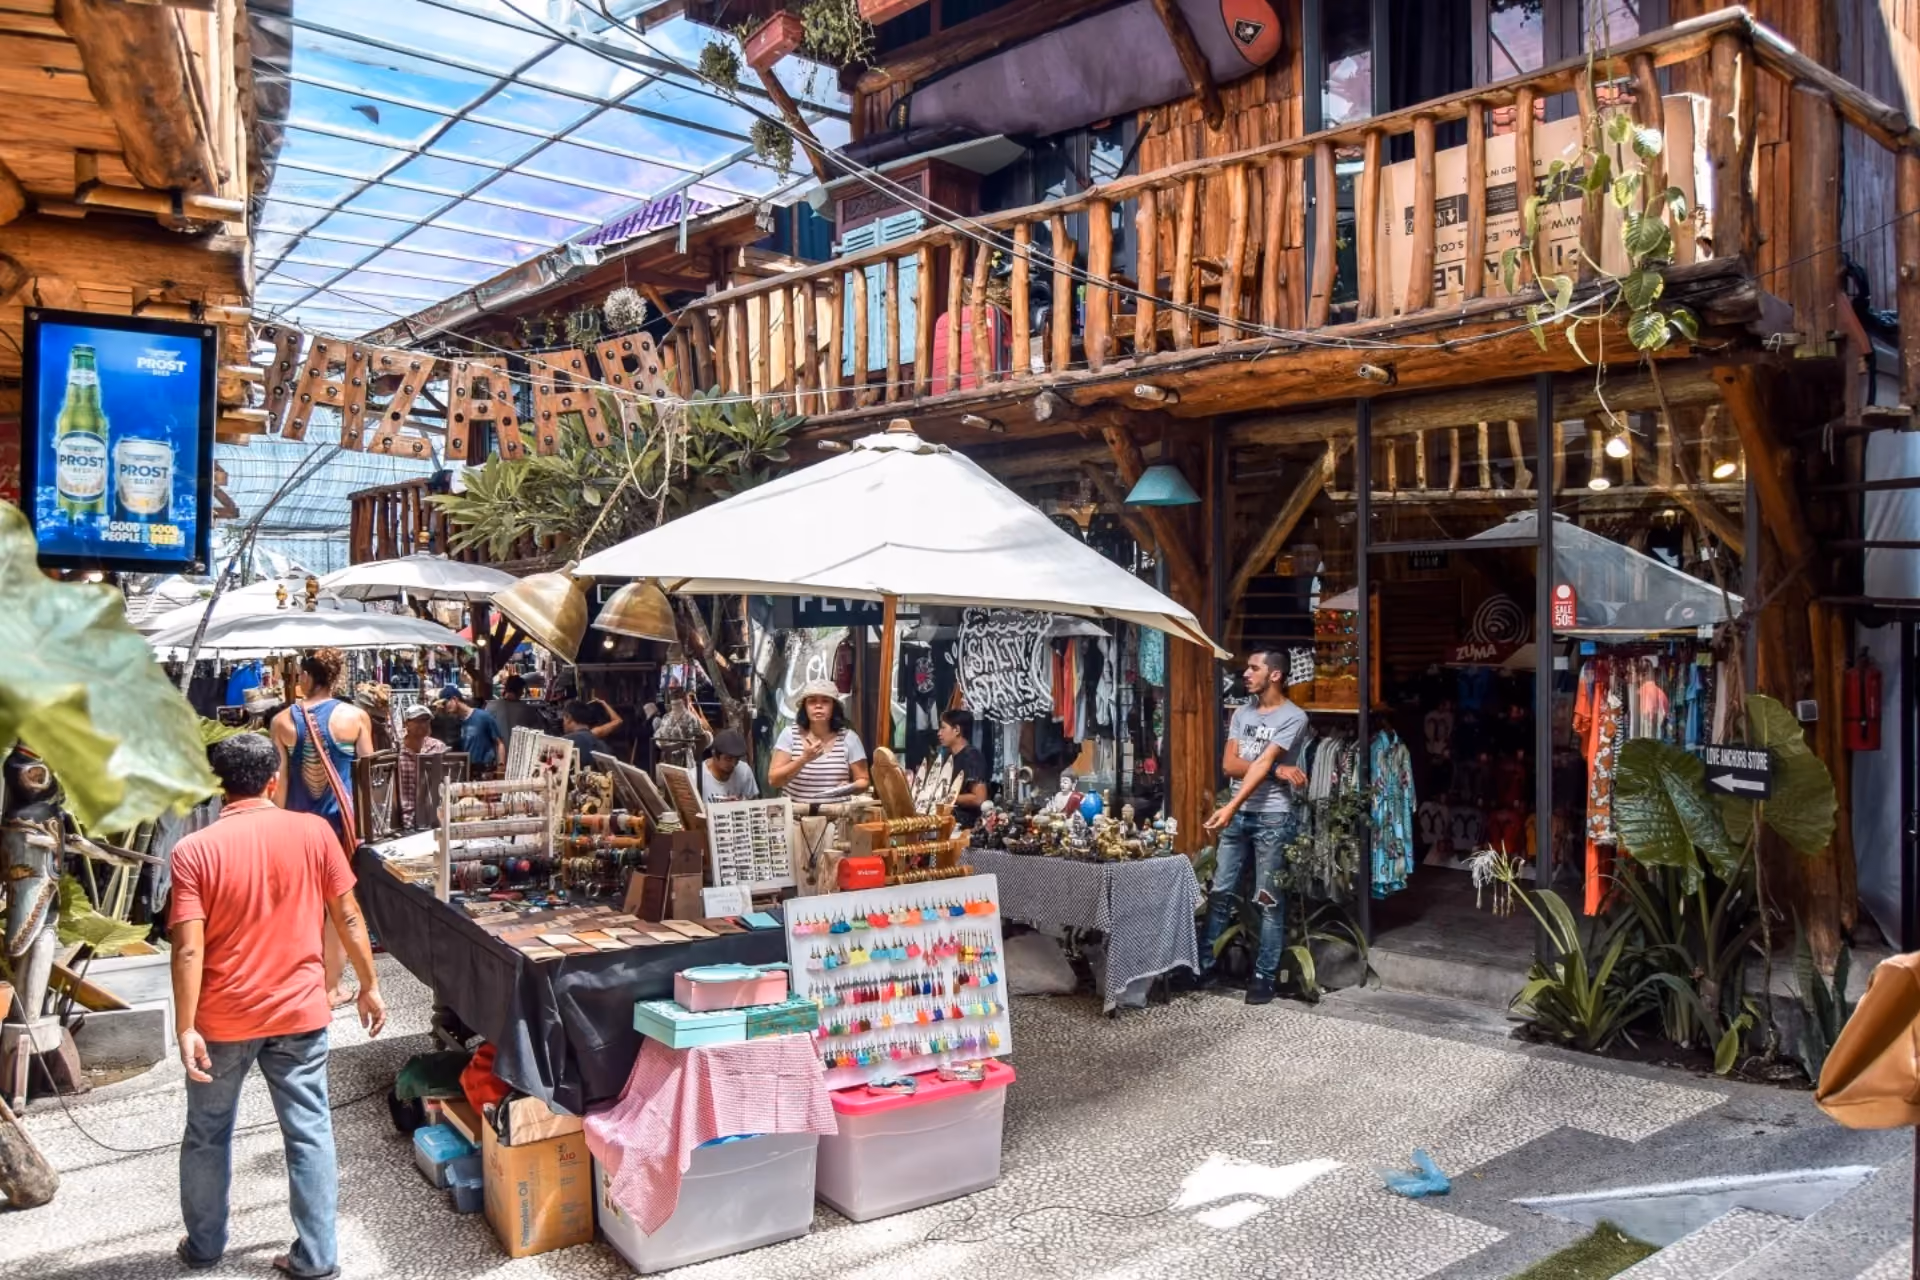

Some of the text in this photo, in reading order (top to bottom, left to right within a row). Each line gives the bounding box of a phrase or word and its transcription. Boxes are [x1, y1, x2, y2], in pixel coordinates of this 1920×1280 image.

[137, 357, 187, 372] PROST
[60, 454, 105, 468] PROST
[120, 463, 169, 479] PROST
[110, 521, 140, 532] GOOD
[101, 531, 140, 543] PEOPLE
[1555, 605, 1572, 614] SALE
[968, 635, 1028, 673] SALTY
[1455, 644, 1497, 661] ZUMA
[972, 671, 1036, 709] DAYS
[1706, 747, 1768, 771] LOVE ANCHORS STORE
[517, 1181, 529, 1197] Oil
